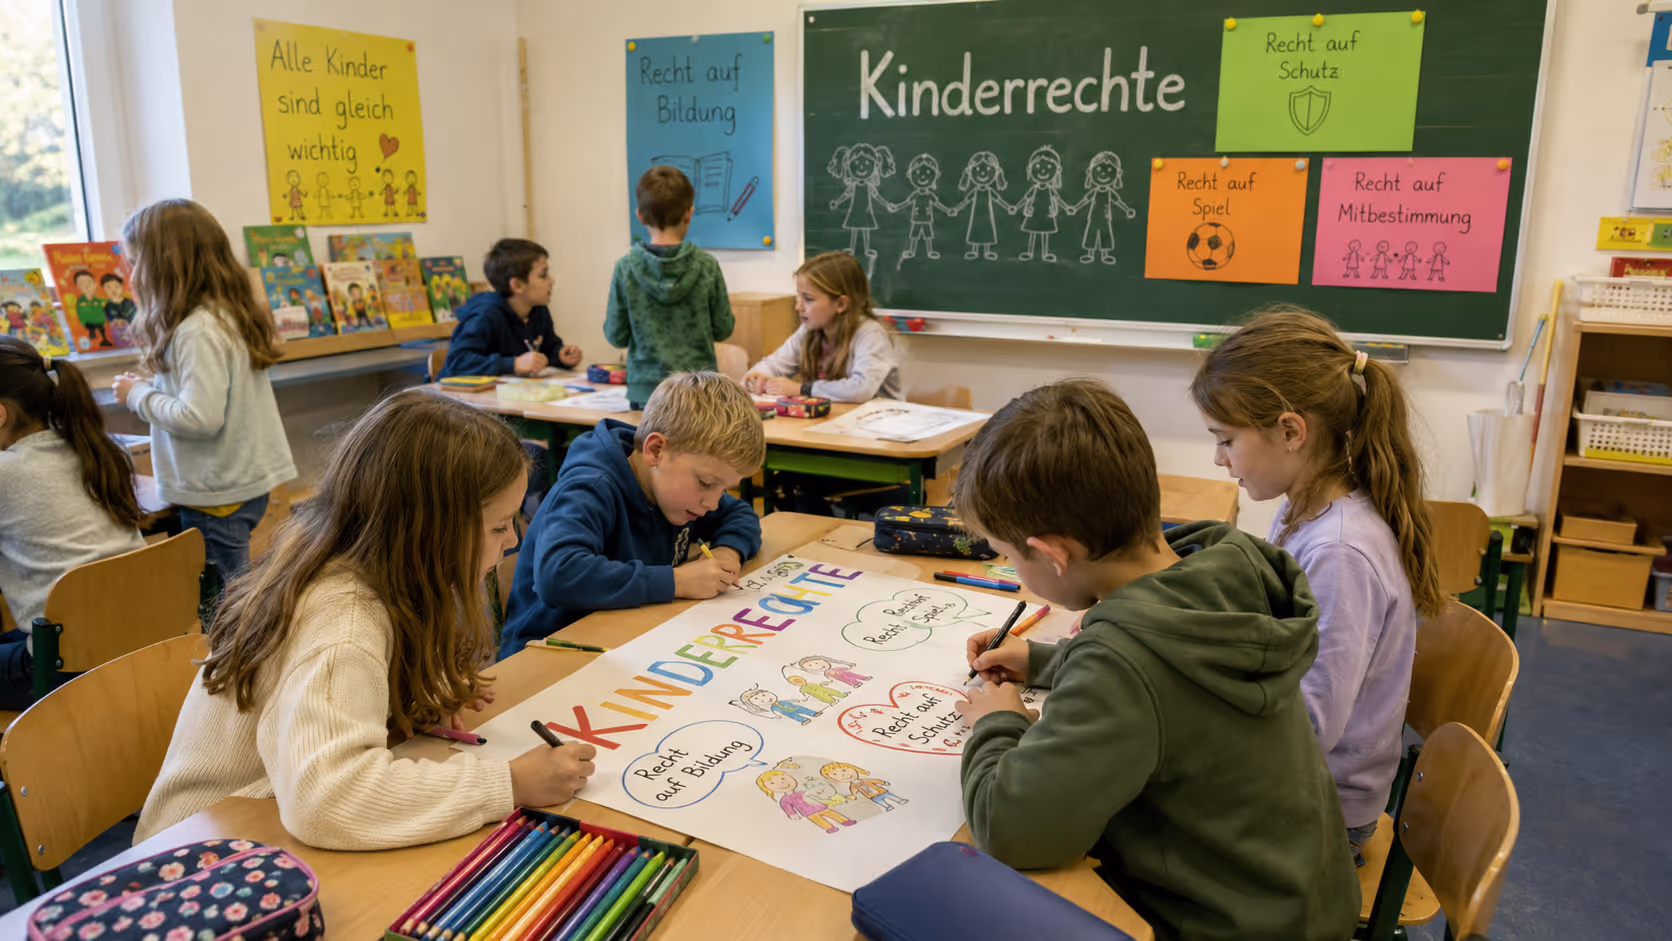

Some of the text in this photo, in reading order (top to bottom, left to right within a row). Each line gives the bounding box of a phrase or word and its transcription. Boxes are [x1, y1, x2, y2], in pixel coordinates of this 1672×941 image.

[1266, 30, 1360, 54] Recht auf
[271, 40, 389, 81] Alle Kinder
[641, 53, 742, 91] Recht auf
[1279, 61, 1340, 81] Schutz
[859, 46, 1186, 119] Kinderrechte
[278, 89, 393, 130] sind gleich
[657, 95, 736, 135] Bildung
[287, 136, 358, 174] wichtig
[1177, 172, 1259, 192] Recht auf
[1355, 172, 1446, 194] Recht auf
[1192, 198, 1231, 221] Spiel
[1338, 203, 1472, 234] Mitbestimmung
[872, 693, 943, 738] Recht auf
[909, 711, 963, 744] Schutz
[634, 748, 689, 780] Recht
[656, 740, 753, 801] auf Bildung
